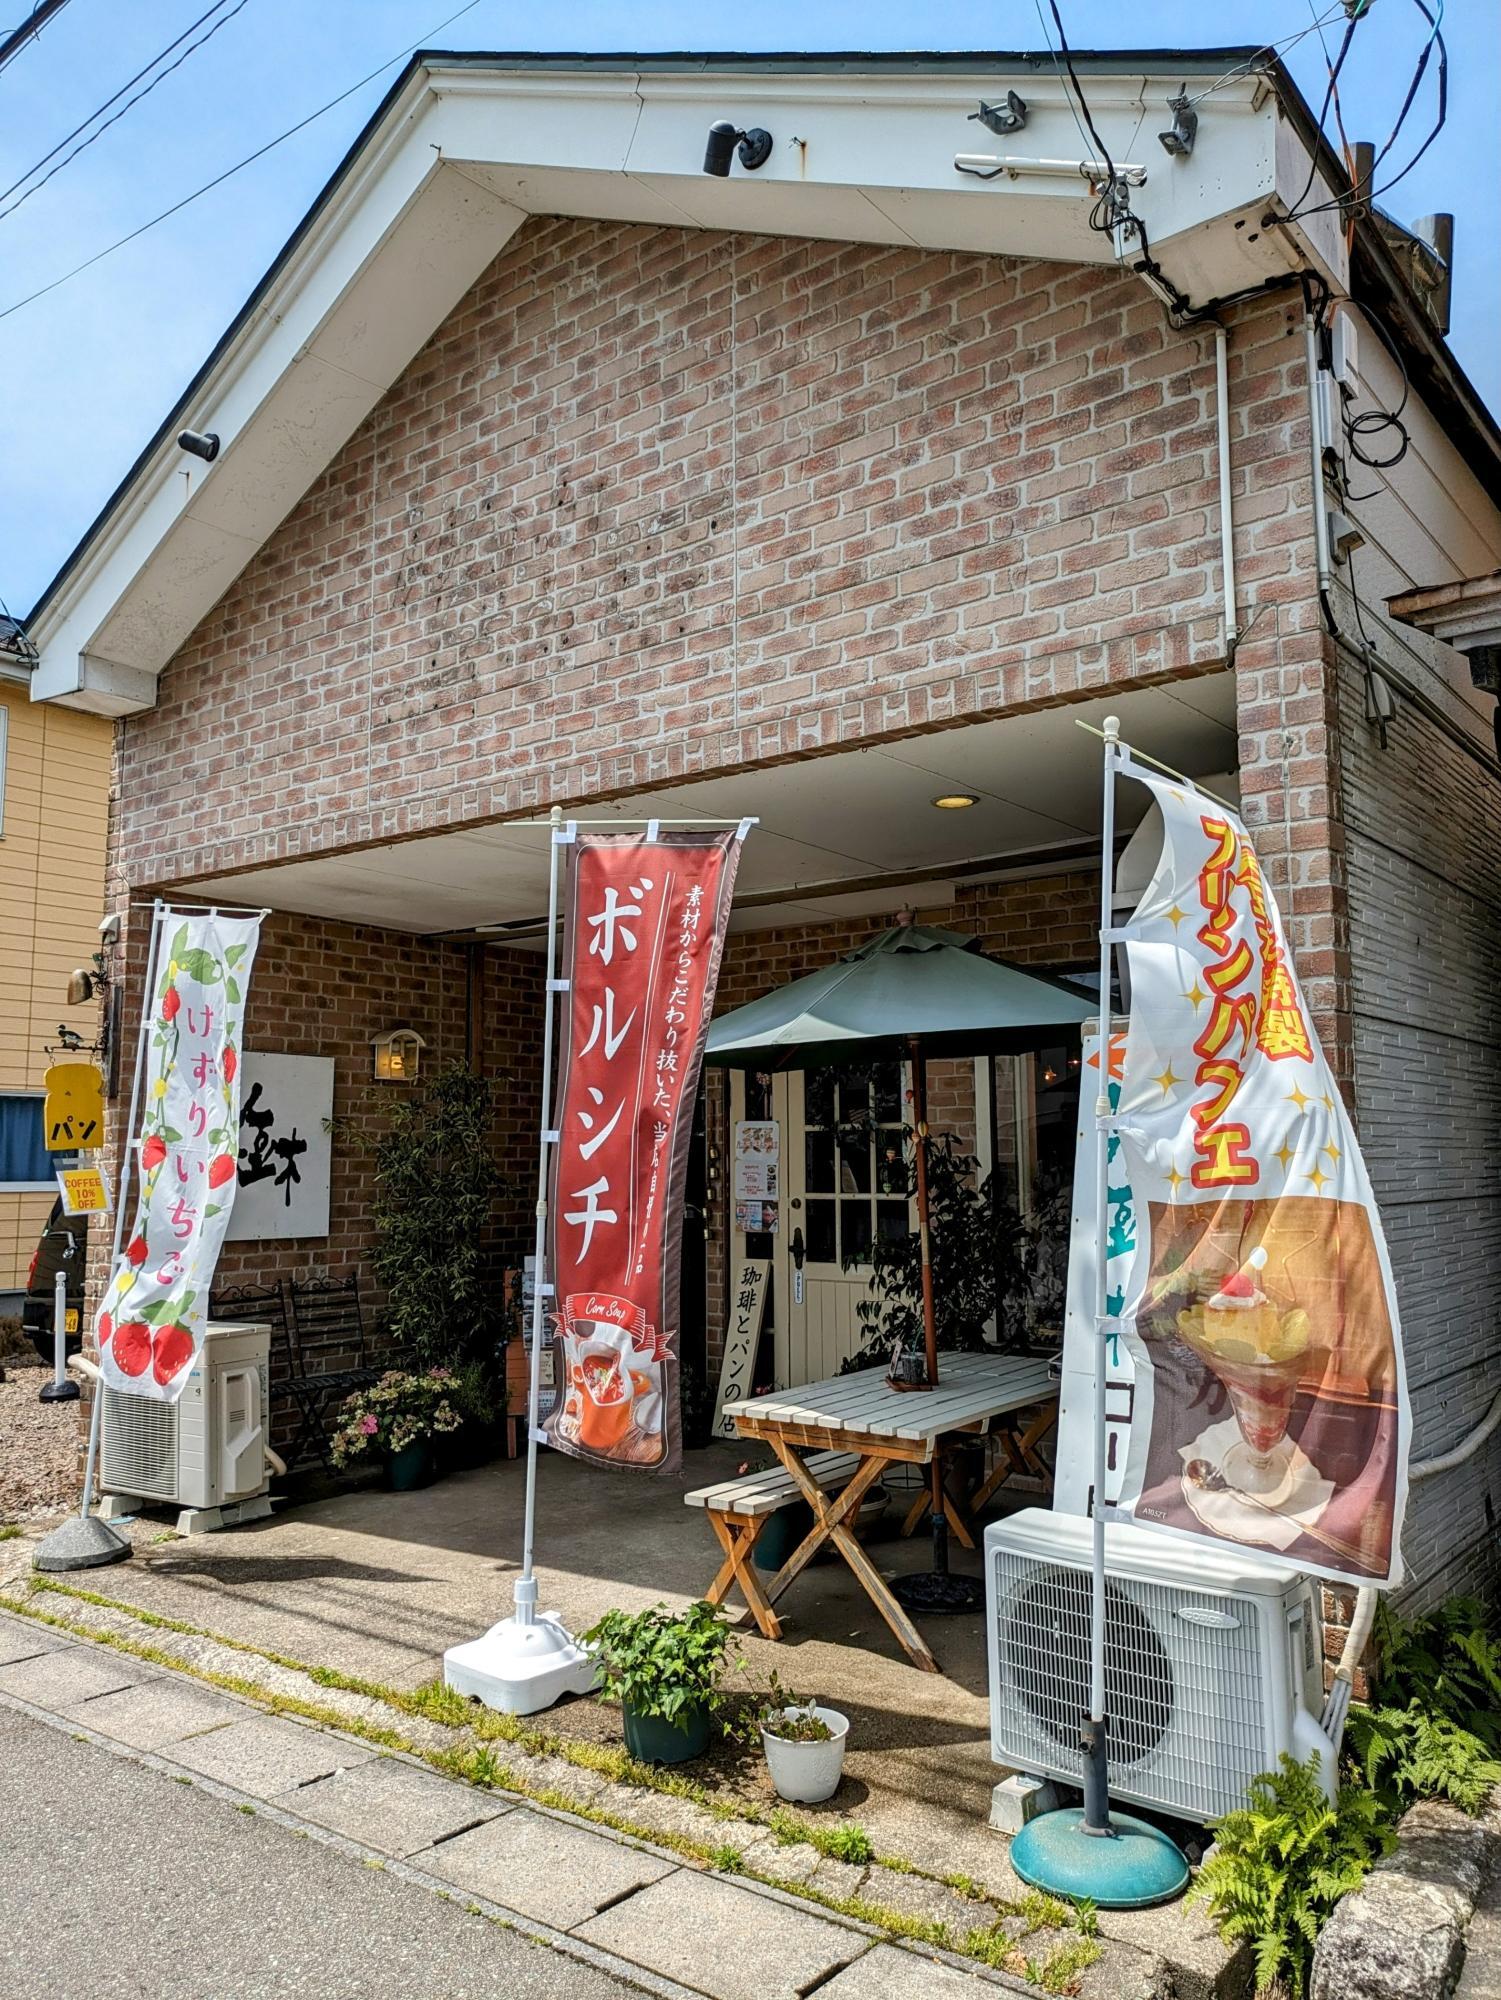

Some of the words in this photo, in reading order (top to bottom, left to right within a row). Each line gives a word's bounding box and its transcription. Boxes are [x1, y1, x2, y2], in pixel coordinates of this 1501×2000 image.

[564, 876, 654, 1265] ボルシチ
[51, 1114, 97, 1141] パン
[156, 1003, 217, 1286] けずりいちご
[64, 1177, 102, 1189] COFFEE
[76, 1189, 97, 1199] 10%
[78, 1199, 97, 1209] OFF
[585, 1297, 605, 1315] Corn
[606, 1300, 627, 1323] Soup
